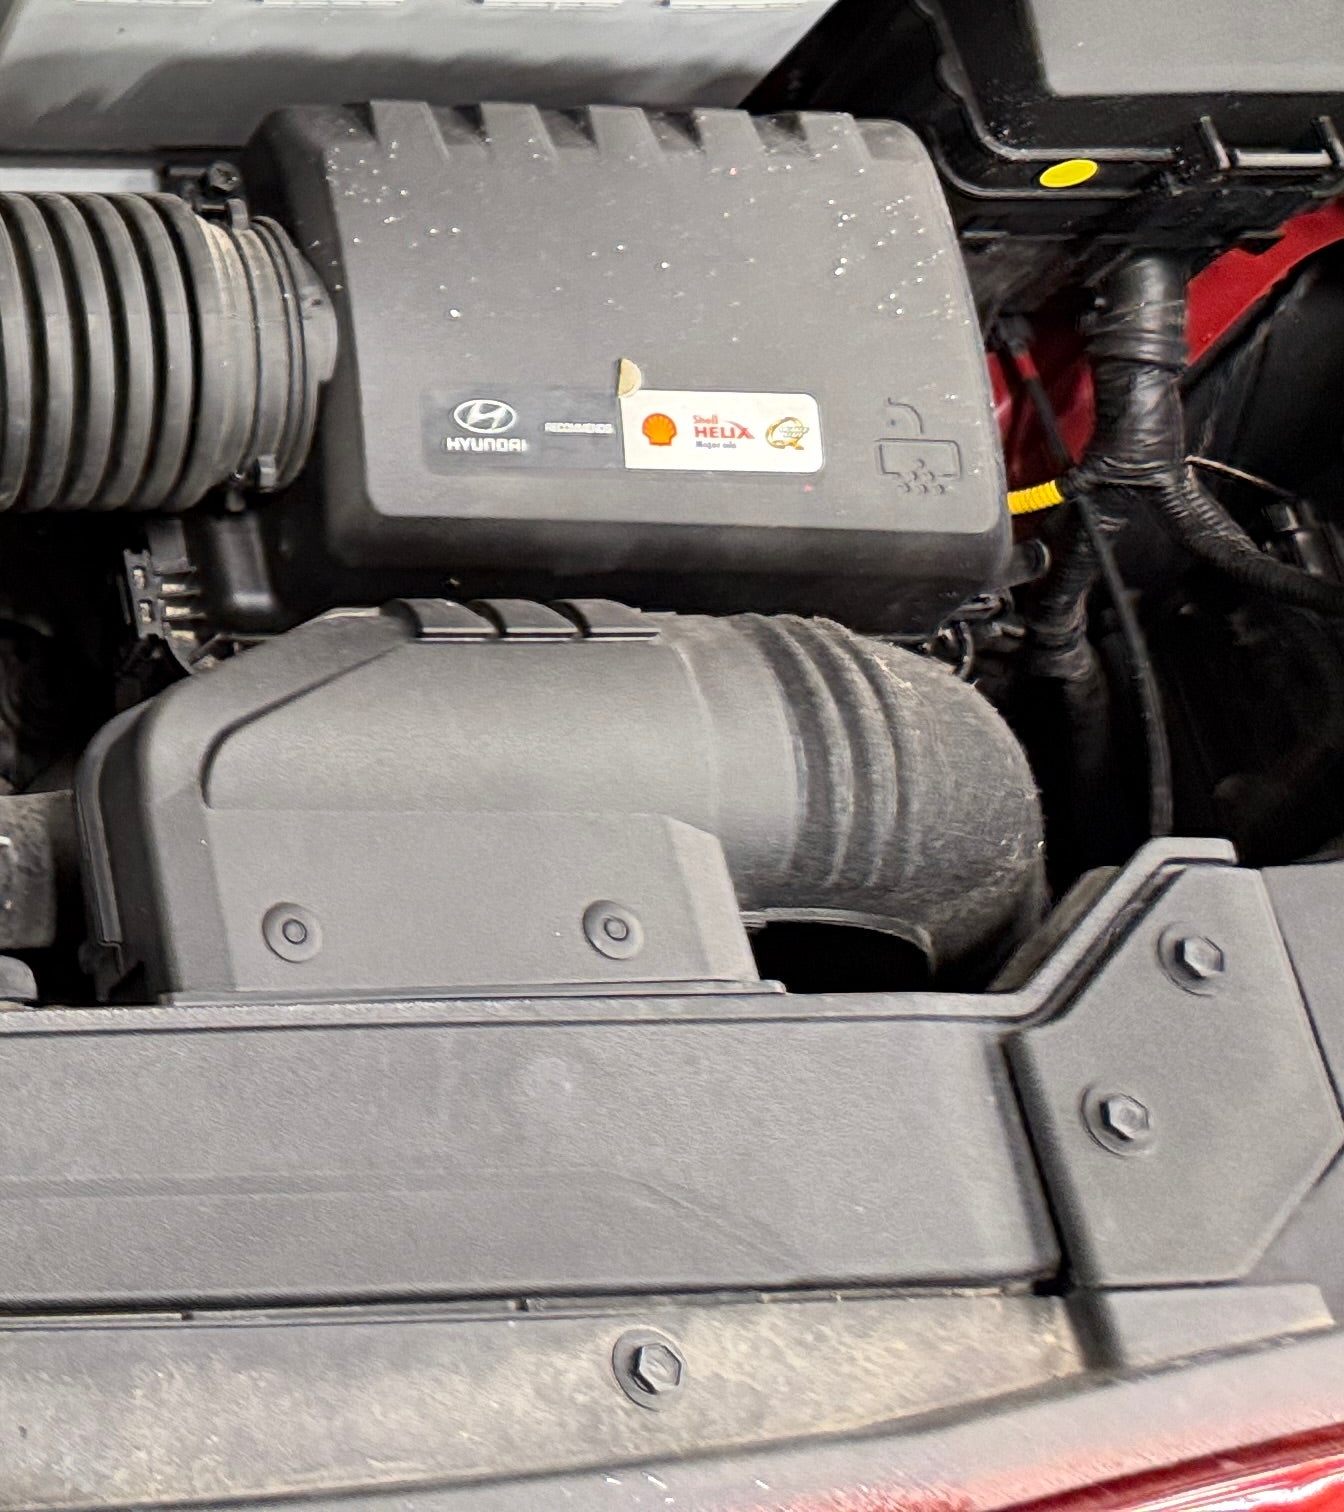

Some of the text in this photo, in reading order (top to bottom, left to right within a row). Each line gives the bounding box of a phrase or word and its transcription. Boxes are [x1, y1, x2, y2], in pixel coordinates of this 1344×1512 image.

[693, 414, 718, 424] Shell
[694, 421, 755, 439] HELIX
[446, 437, 527, 452] HYUNDAI
